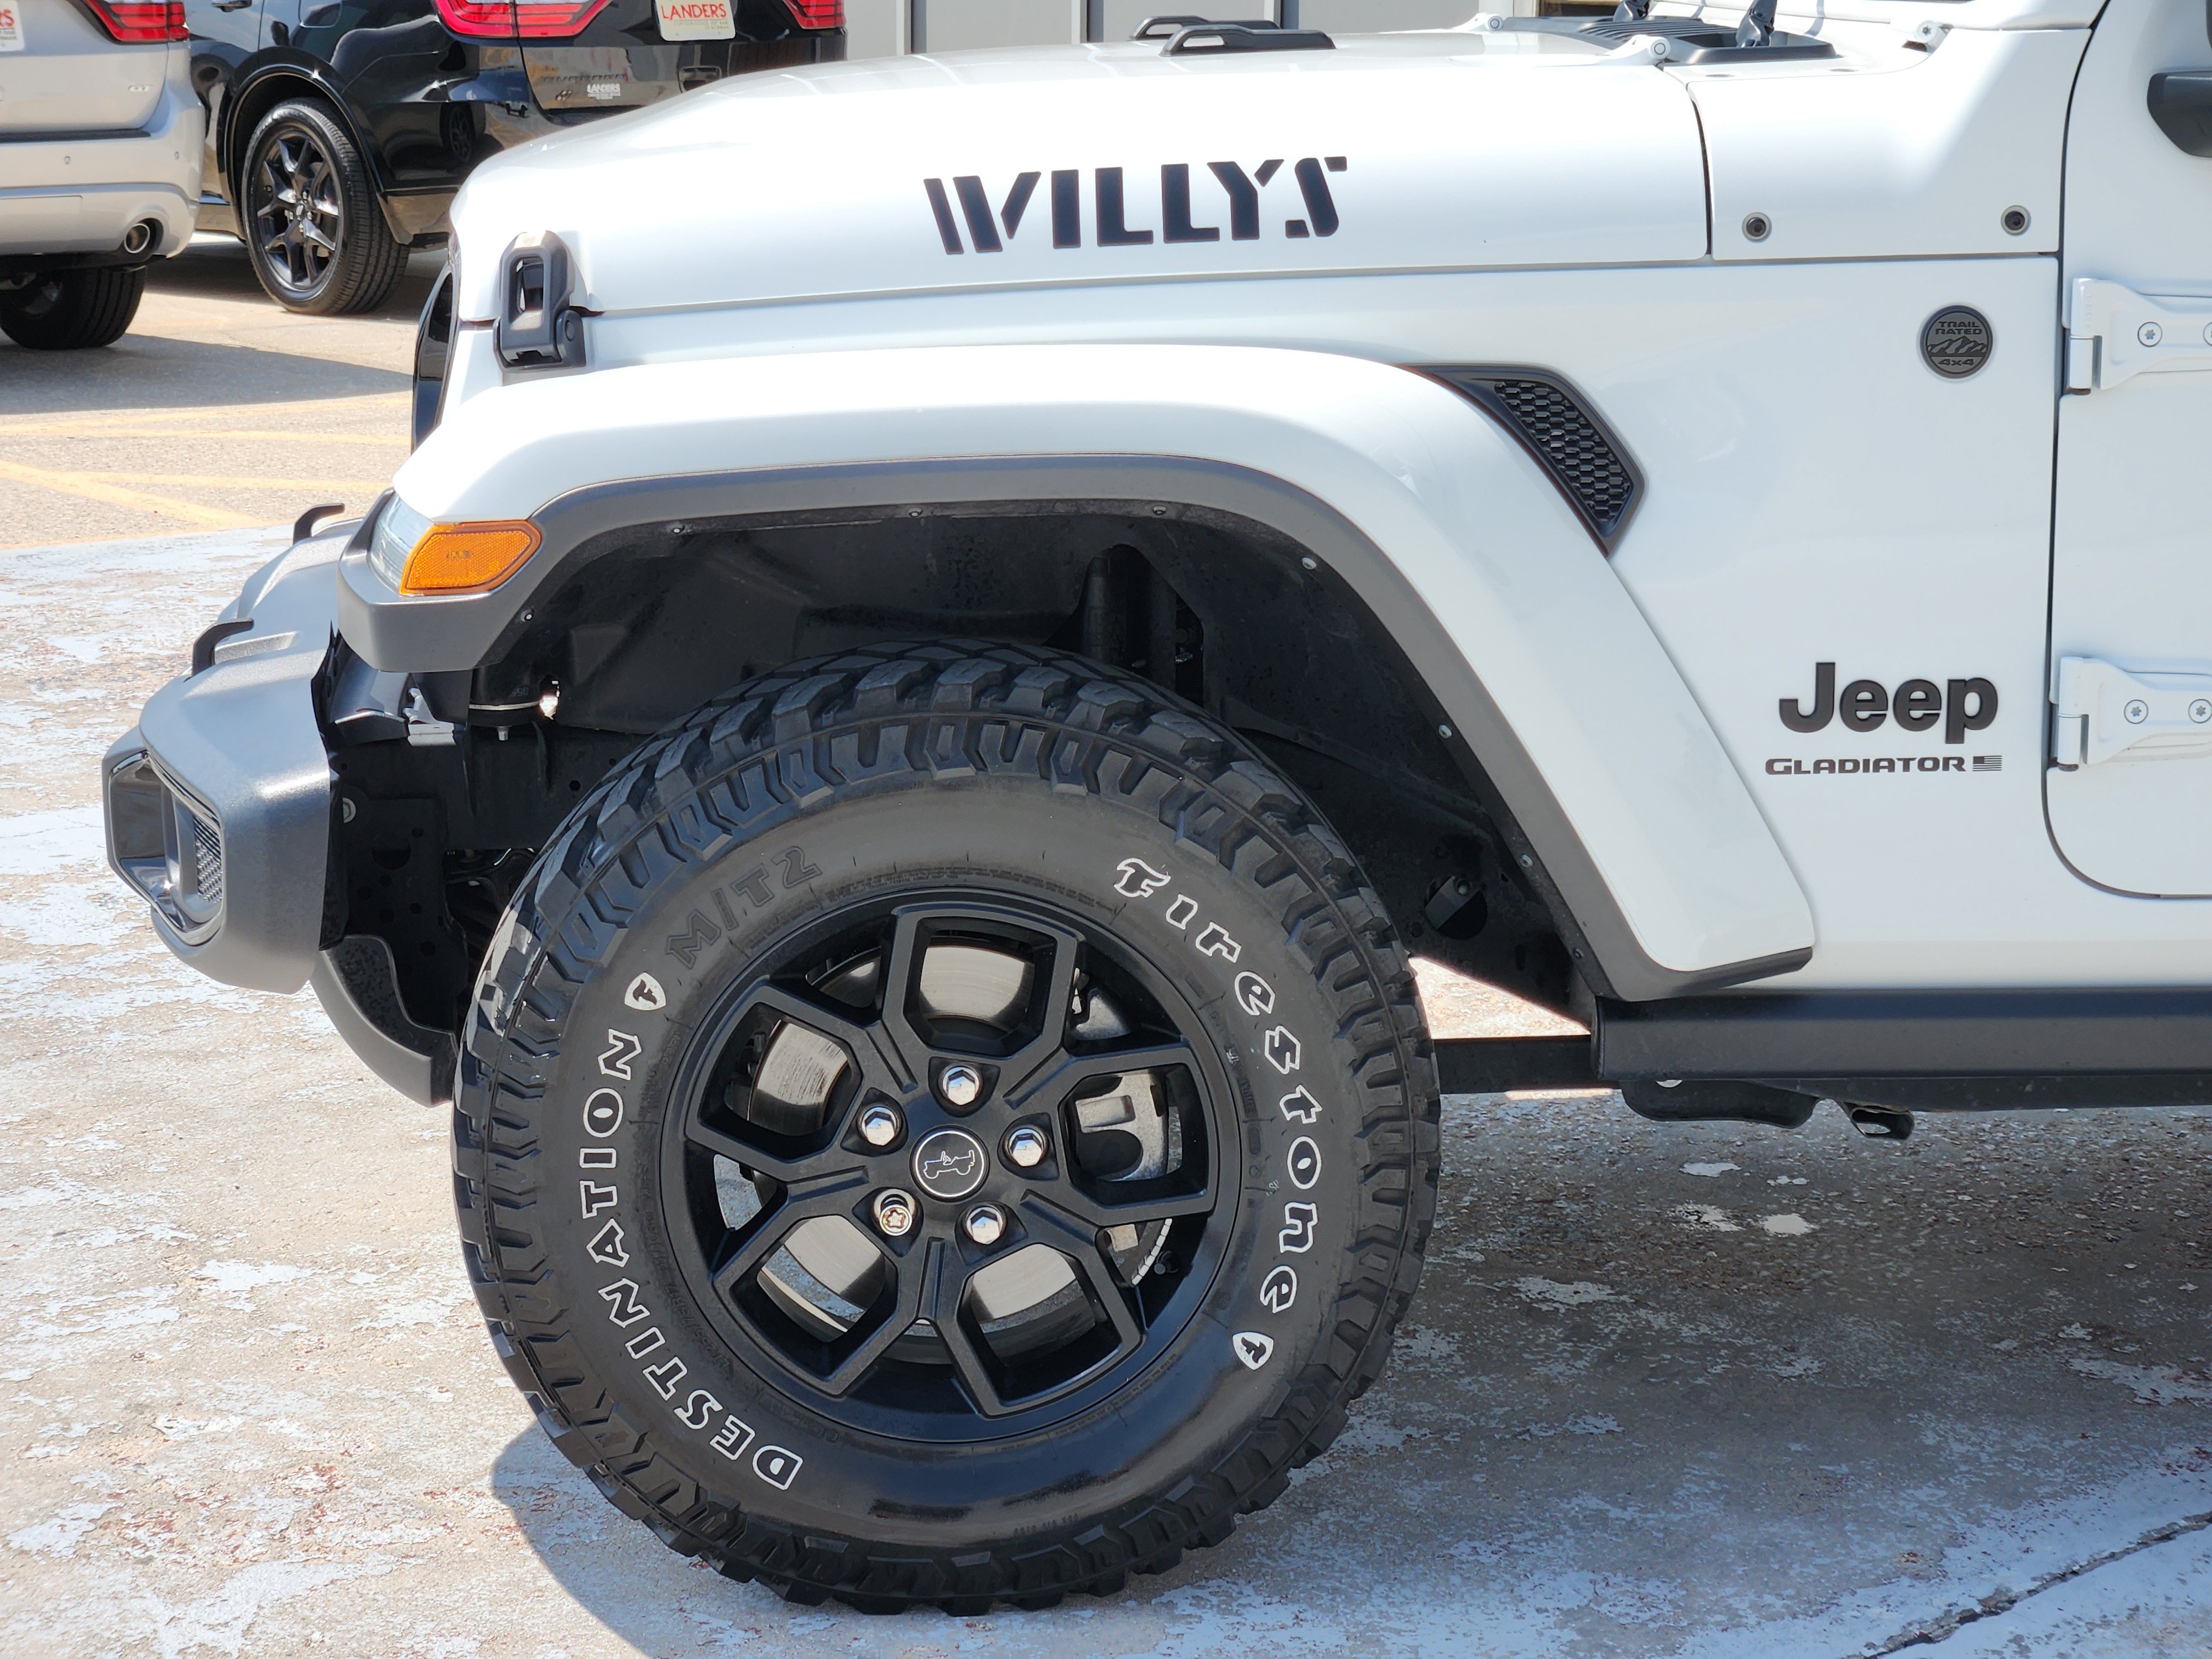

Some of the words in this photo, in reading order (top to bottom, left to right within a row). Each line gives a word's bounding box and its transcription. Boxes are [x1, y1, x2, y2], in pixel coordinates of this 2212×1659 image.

[661, 3, 727, 20] LANDERS
[923, 156, 1347, 255] WILLYS
[1778, 661, 1998, 744] Jeep
[1765, 756, 1966, 775] GLADIATOR
[666, 846, 823, 969] M/T2
[1114, 857, 1323, 1314] Firestone
[580, 1029, 804, 1491] DESTINATION
